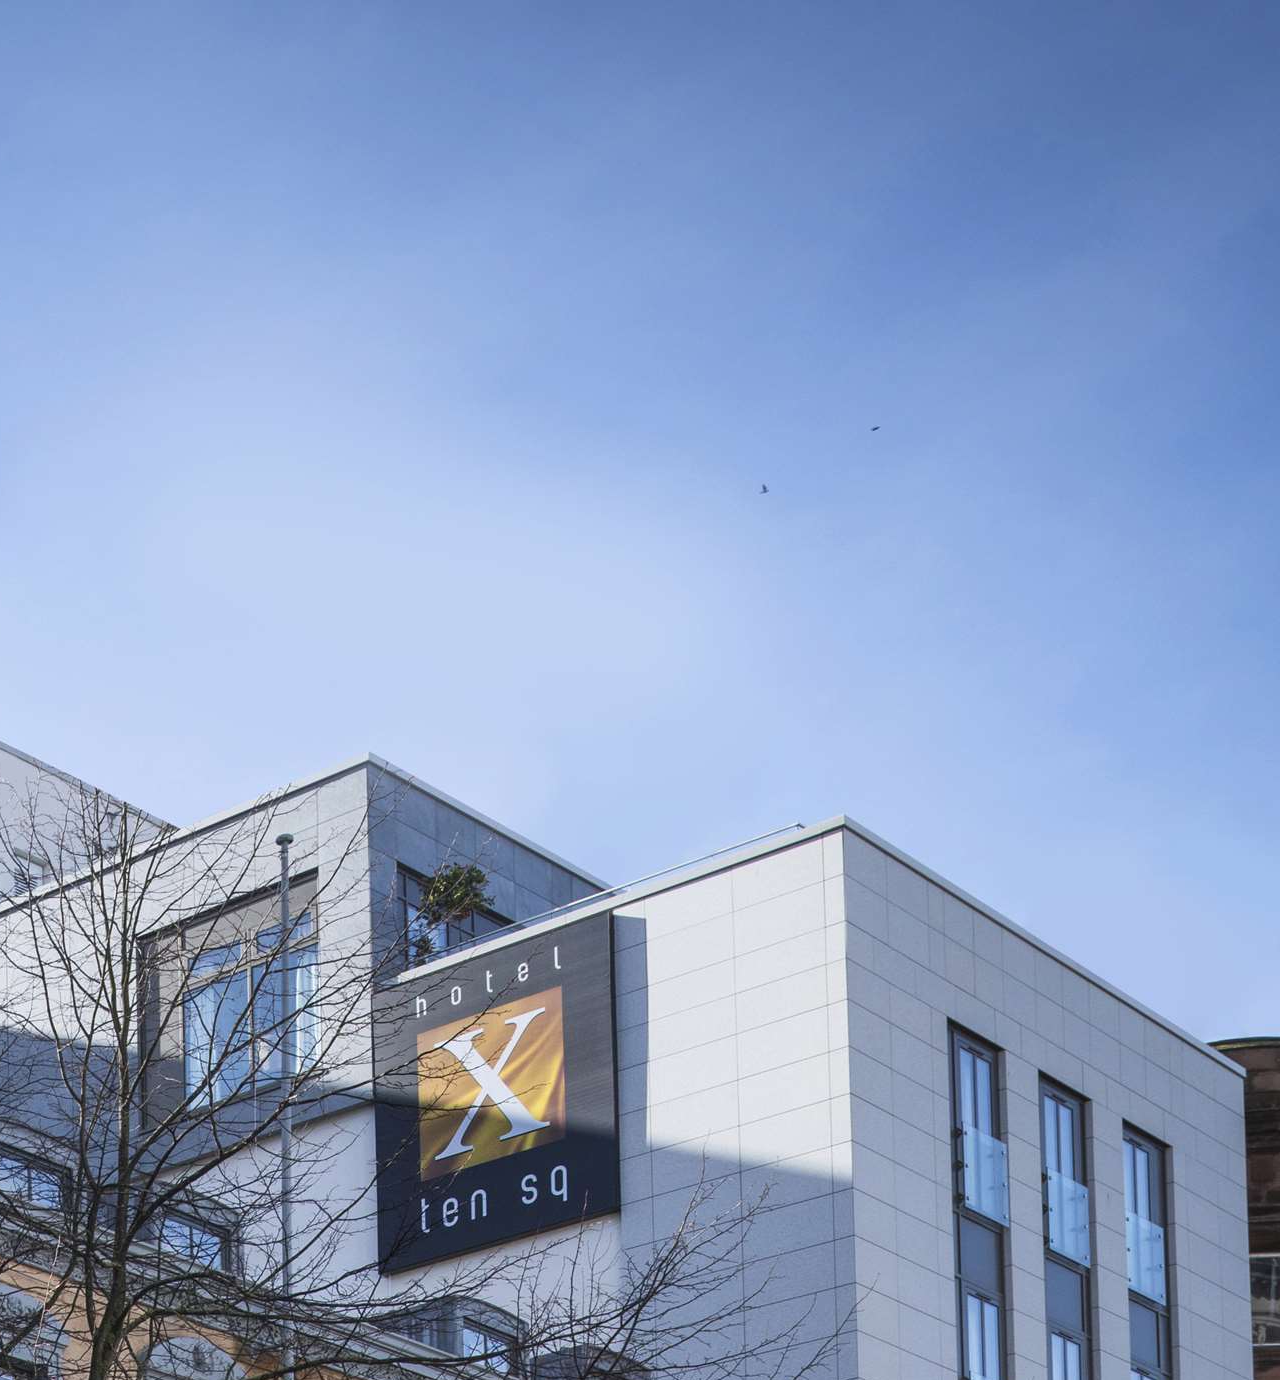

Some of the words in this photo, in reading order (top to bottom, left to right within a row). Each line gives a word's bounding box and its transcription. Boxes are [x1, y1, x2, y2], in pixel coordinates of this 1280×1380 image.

[416, 946, 562, 1019] hotel
[433, 1006, 551, 1161] X
[420, 1188, 488, 1234] ten
[521, 1164, 569, 1207] sq
